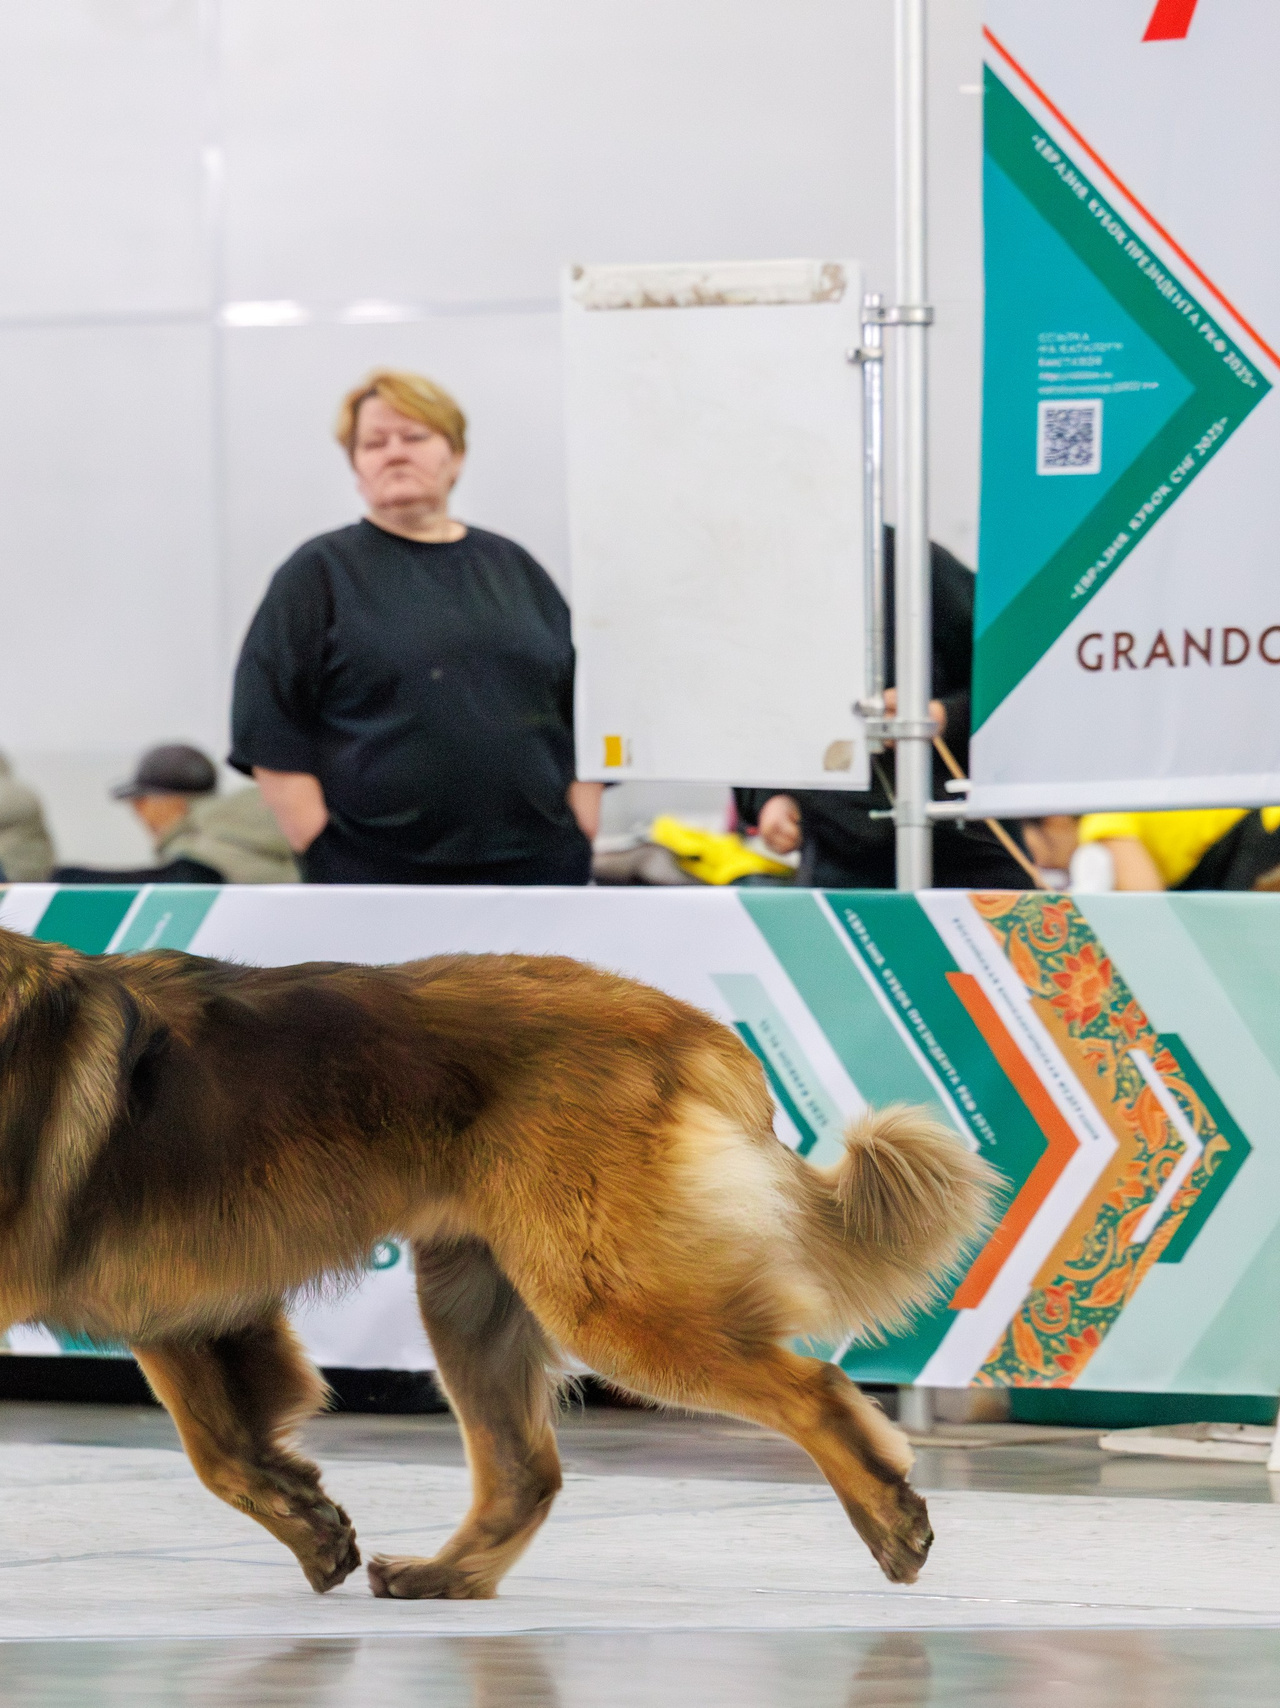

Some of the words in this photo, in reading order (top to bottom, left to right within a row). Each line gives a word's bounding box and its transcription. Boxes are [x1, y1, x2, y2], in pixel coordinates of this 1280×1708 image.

[1088, 198, 1127, 244] КУБОК
[1124, 239, 1199, 325] ПРЕЗИДЕНТА
[1199, 322, 1226, 352] РКФ
[1128, 484, 1171, 530] КУБОК
[1169, 453, 1195, 483] СНГ
[882, 968, 911, 1009] КУБОК
